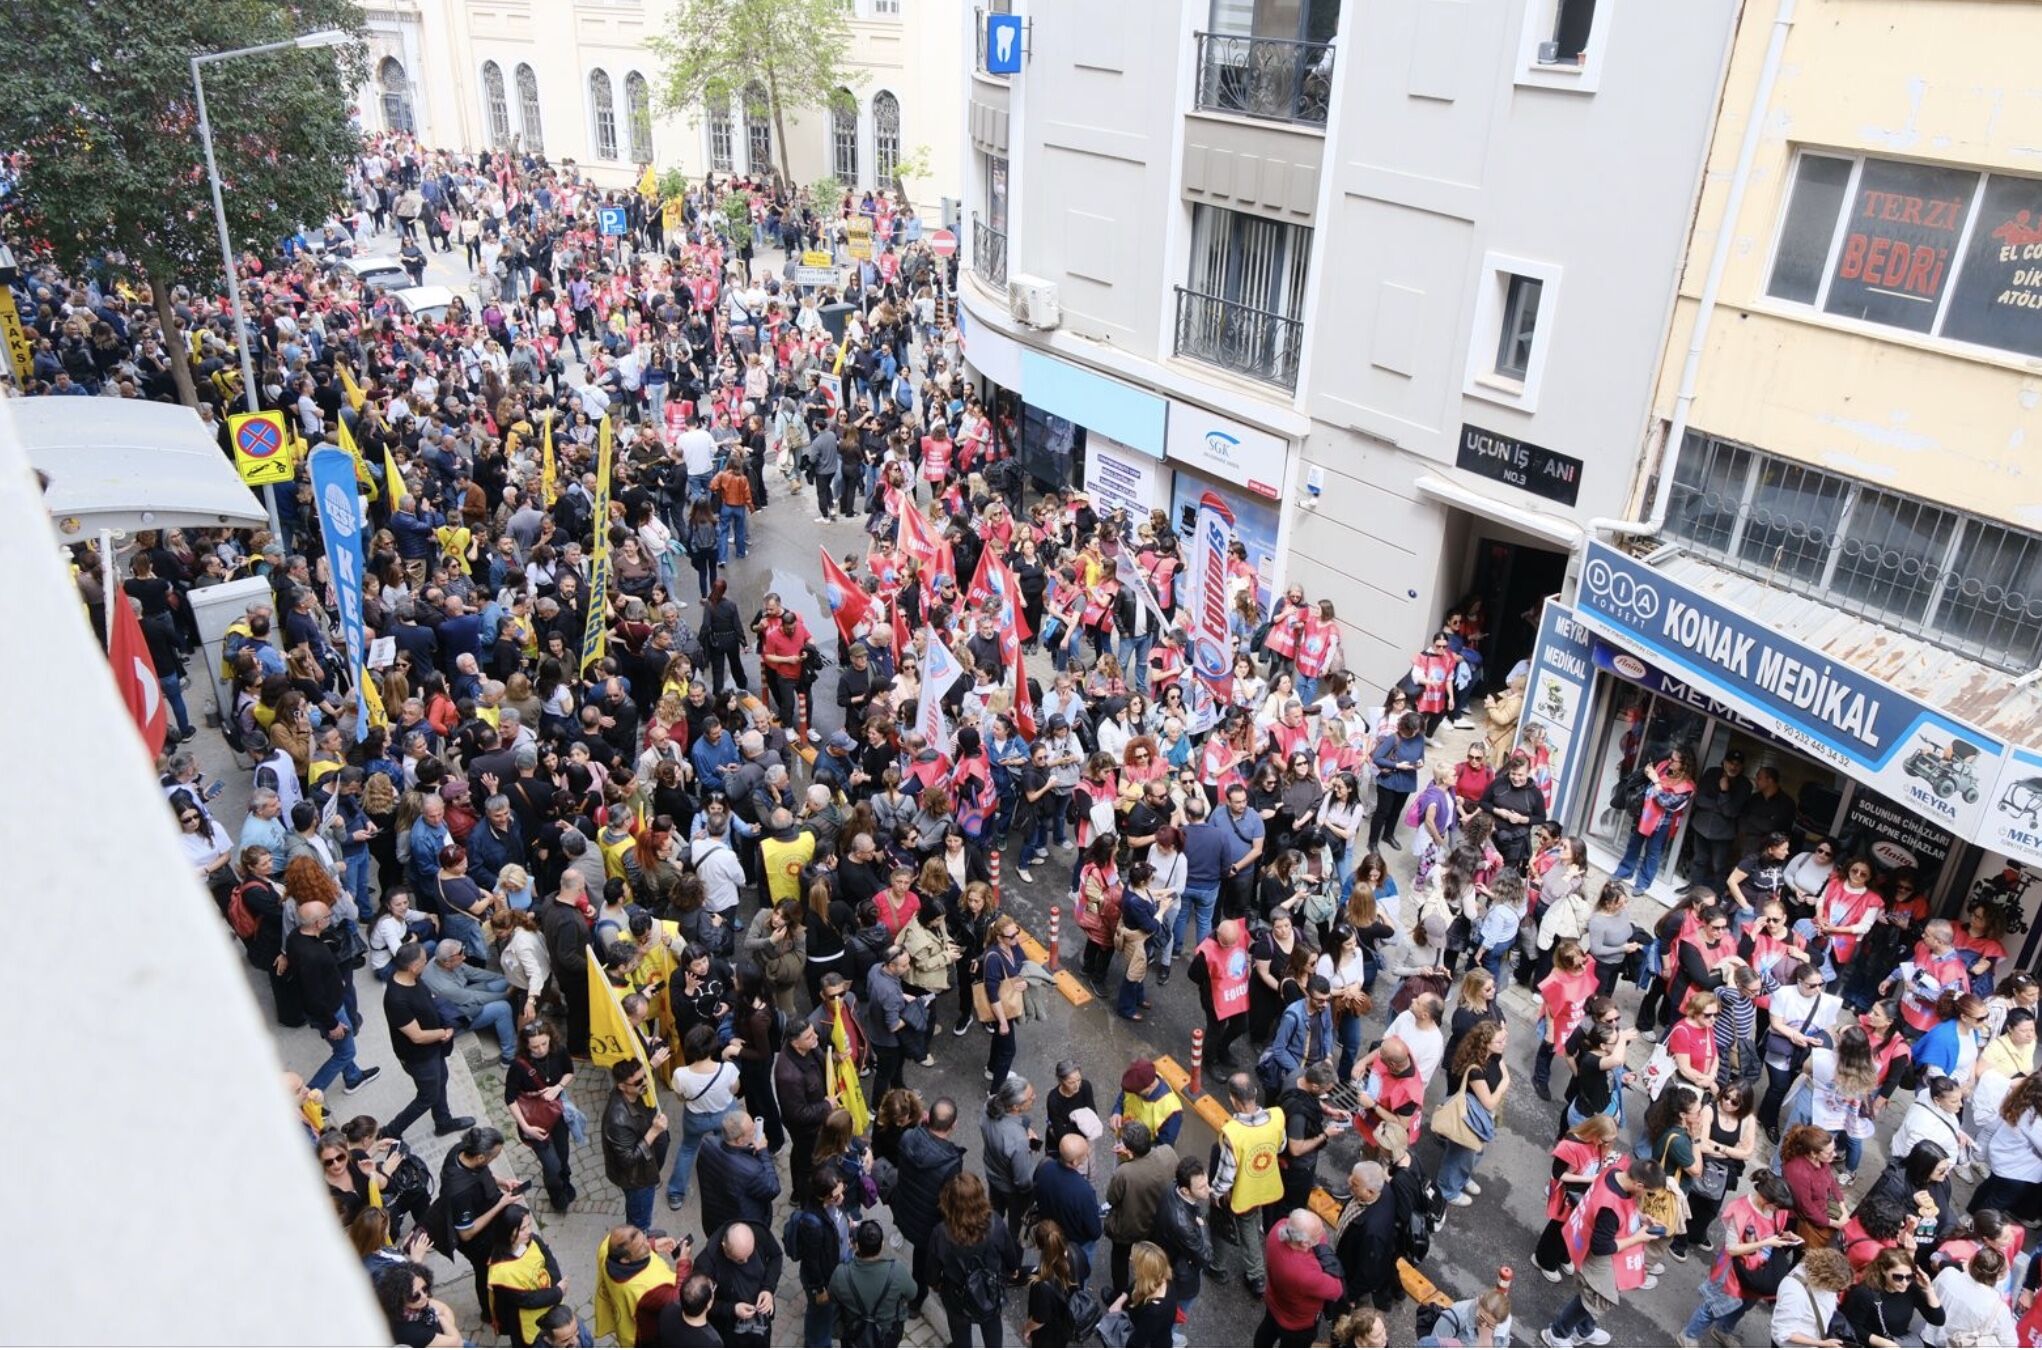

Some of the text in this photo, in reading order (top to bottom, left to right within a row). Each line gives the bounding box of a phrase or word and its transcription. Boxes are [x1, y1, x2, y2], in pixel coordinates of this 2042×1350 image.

[602, 210, 618, 233] P
[1864, 190, 1963, 231] TERZİ
[1999, 245, 2018, 262] EL
[1208, 438, 1231, 458] SGK
[1466, 432, 1511, 461] UÇUN
[1503, 469, 1527, 486] NO.3
[1554, 615, 1590, 647] MEYRA
[1543, 645, 1586, 681] MEDİKAL
[1662, 598, 1881, 748] KONAK MEDİKAL
[1795, 731, 1810, 746] 232
[1811, 740, 1826, 754] 445
[1838, 755, 1850, 768] 32
[1858, 799, 1901, 824] SOLUNUM
[1910, 786, 1956, 818] MEYRA
[1851, 810, 1876, 828] UYKU
[1876, 822, 1900, 840] APNE
